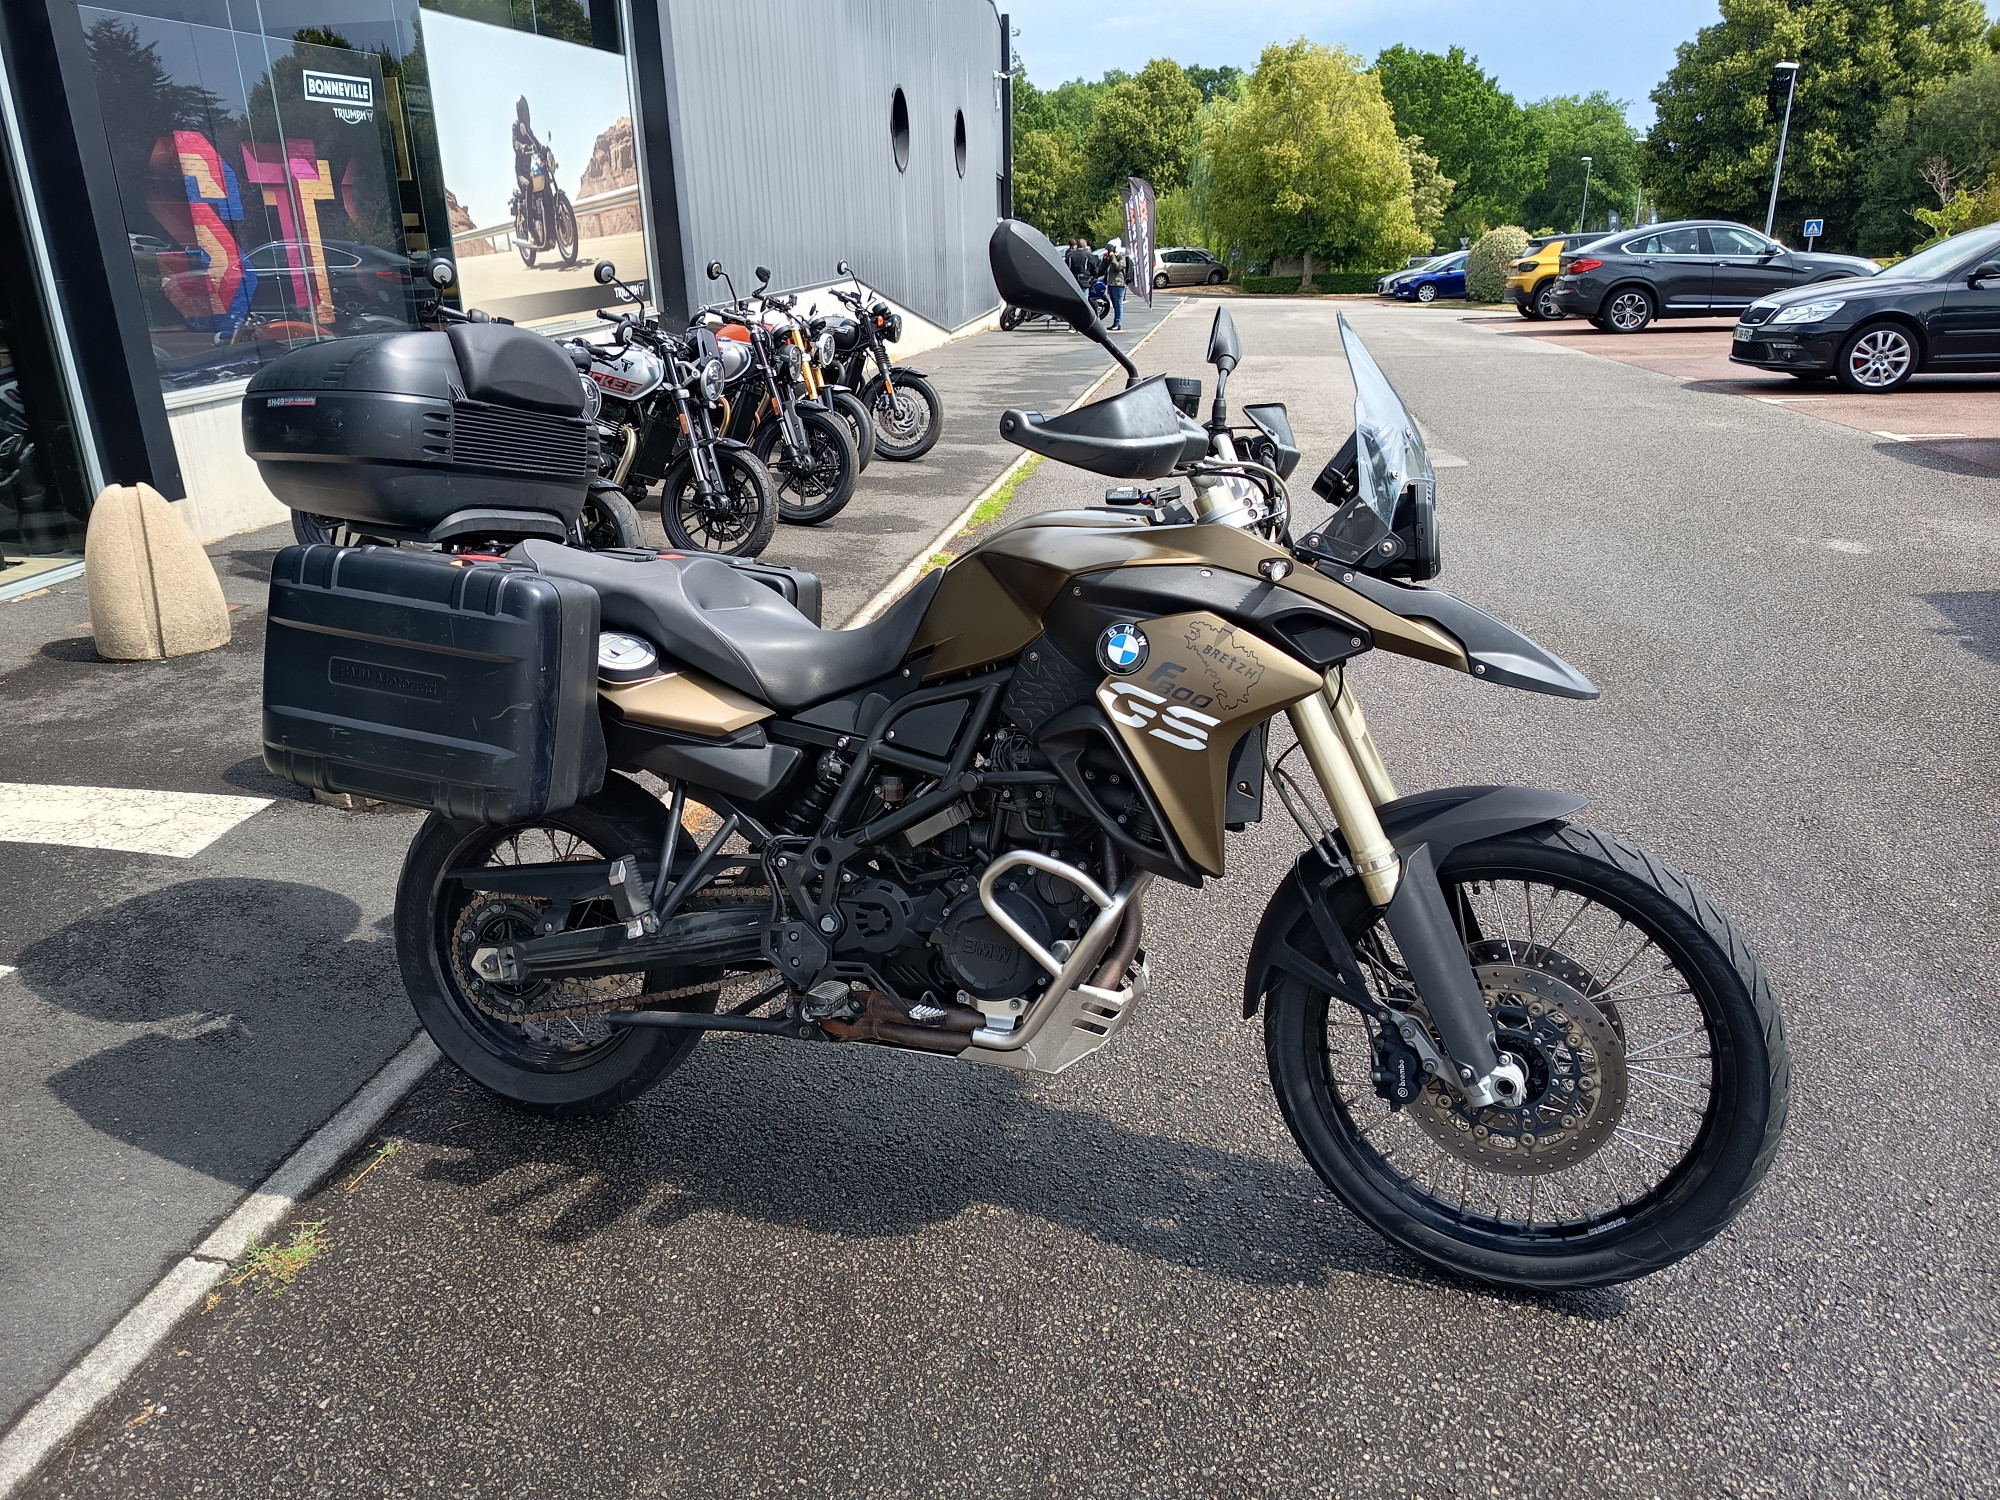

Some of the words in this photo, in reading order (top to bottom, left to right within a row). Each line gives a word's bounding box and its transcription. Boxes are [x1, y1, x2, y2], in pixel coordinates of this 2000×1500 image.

[308, 78, 369, 99] BONNEVILLE
[333, 107, 367, 124] TRIUMPH
[267, 398, 284, 407] SH49
[1108, 626, 1148, 647] BMW
[1146, 661, 1188, 683] F
[1154, 681, 1214, 709] 800
[1098, 681, 1222, 751] GS
[963, 936, 1012, 964] BMW
[1398, 1059, 1406, 1087] brembo
